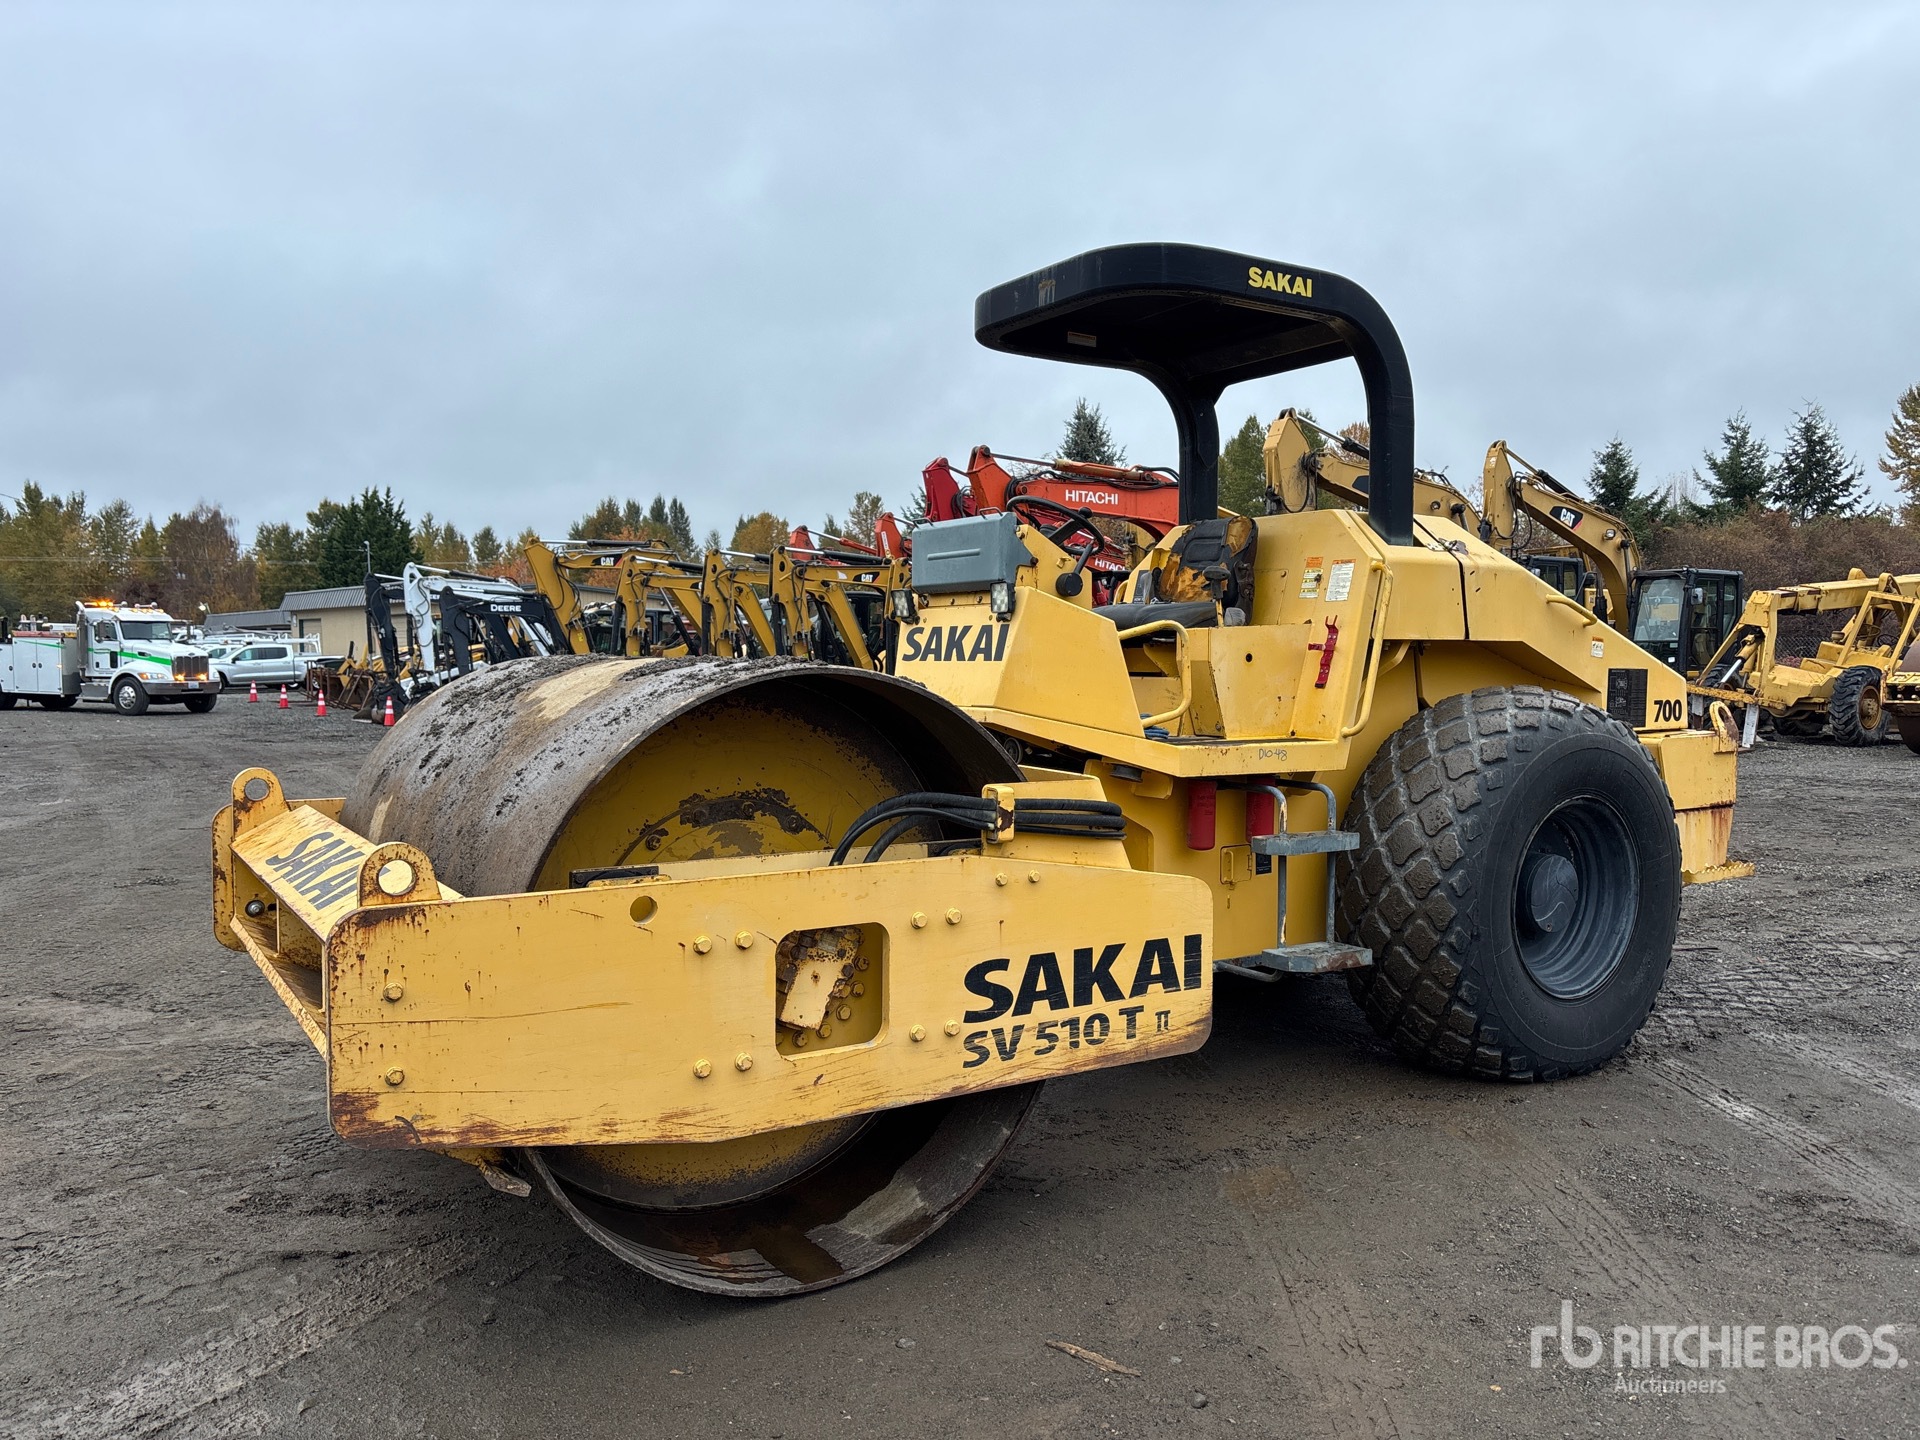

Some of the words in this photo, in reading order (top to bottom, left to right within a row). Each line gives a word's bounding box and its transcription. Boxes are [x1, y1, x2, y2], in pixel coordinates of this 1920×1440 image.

[1248, 266, 1312, 298] SAKAI
[1065, 489, 1119, 505] HITACHI
[1560, 508, 1576, 527] CAT
[600, 556, 615, 567] CAT
[1094, 557, 1126, 571] HITAC
[861, 573, 874, 583] CAT
[490, 603, 522, 612] DEERE
[902, 623, 1010, 662] SAKAI
[1653, 699, 1682, 722] 700
[962, 933, 1202, 1023] SAKAI
[962, 1024, 1025, 1068] SV
[1034, 1012, 1111, 1056] 510
